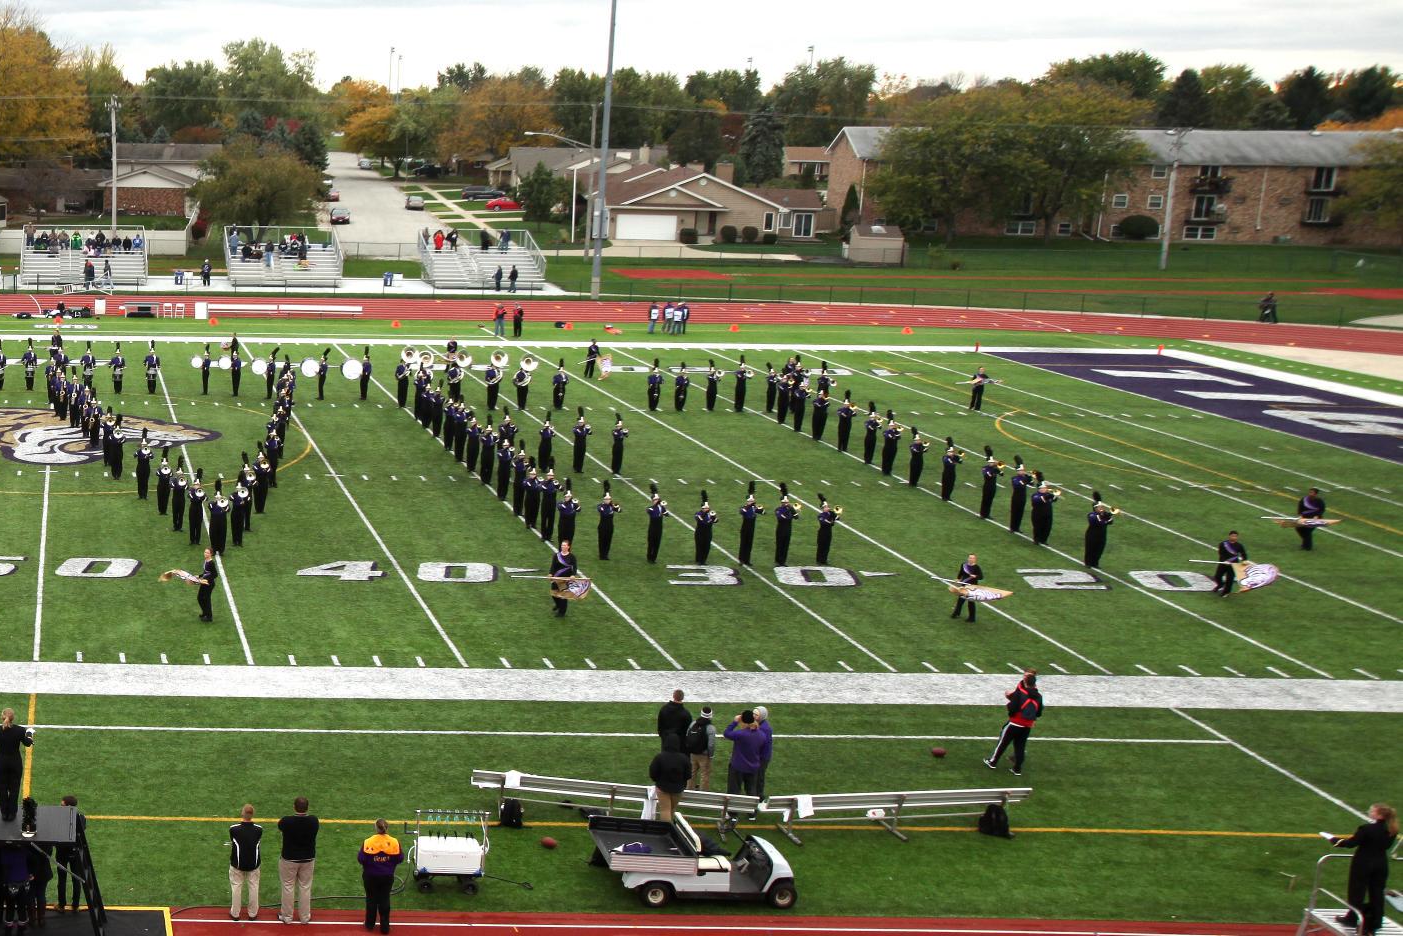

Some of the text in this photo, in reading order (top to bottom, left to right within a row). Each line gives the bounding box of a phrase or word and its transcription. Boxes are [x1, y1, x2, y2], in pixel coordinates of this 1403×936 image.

[298, 560, 496, 583] 40
[666, 564, 861, 588] 30
[1016, 568, 1219, 591] 20
